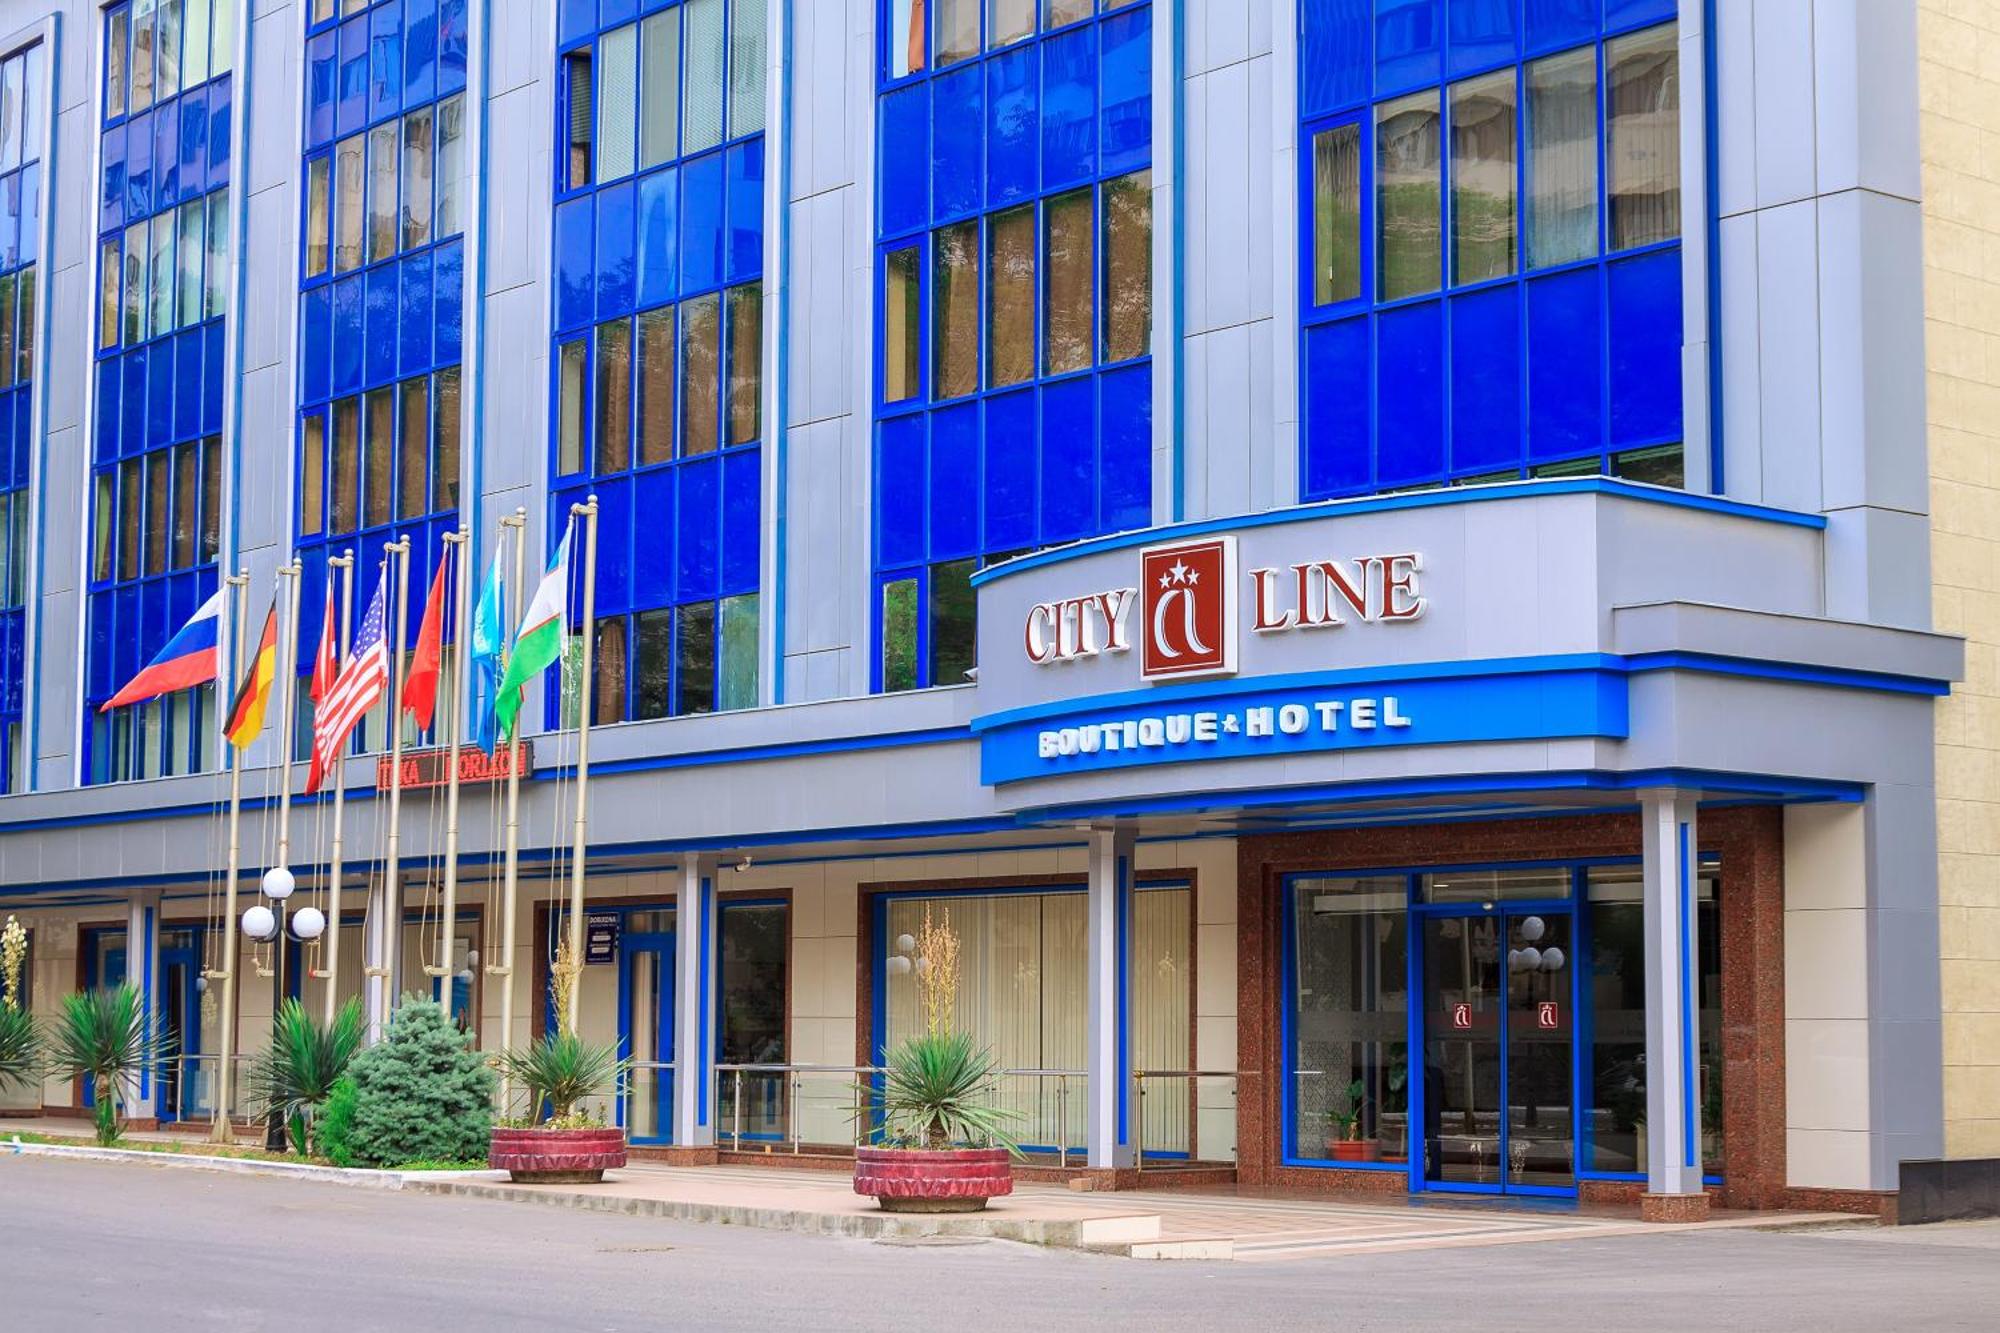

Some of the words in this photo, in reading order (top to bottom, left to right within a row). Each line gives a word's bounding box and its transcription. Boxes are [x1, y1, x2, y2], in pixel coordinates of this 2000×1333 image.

[1024, 587, 1138, 664] CITY
[1248, 552, 1428, 632] LINE
[1039, 712, 1218, 758] BOUTIQUE
[1246, 696, 1412, 737] HOTEL
